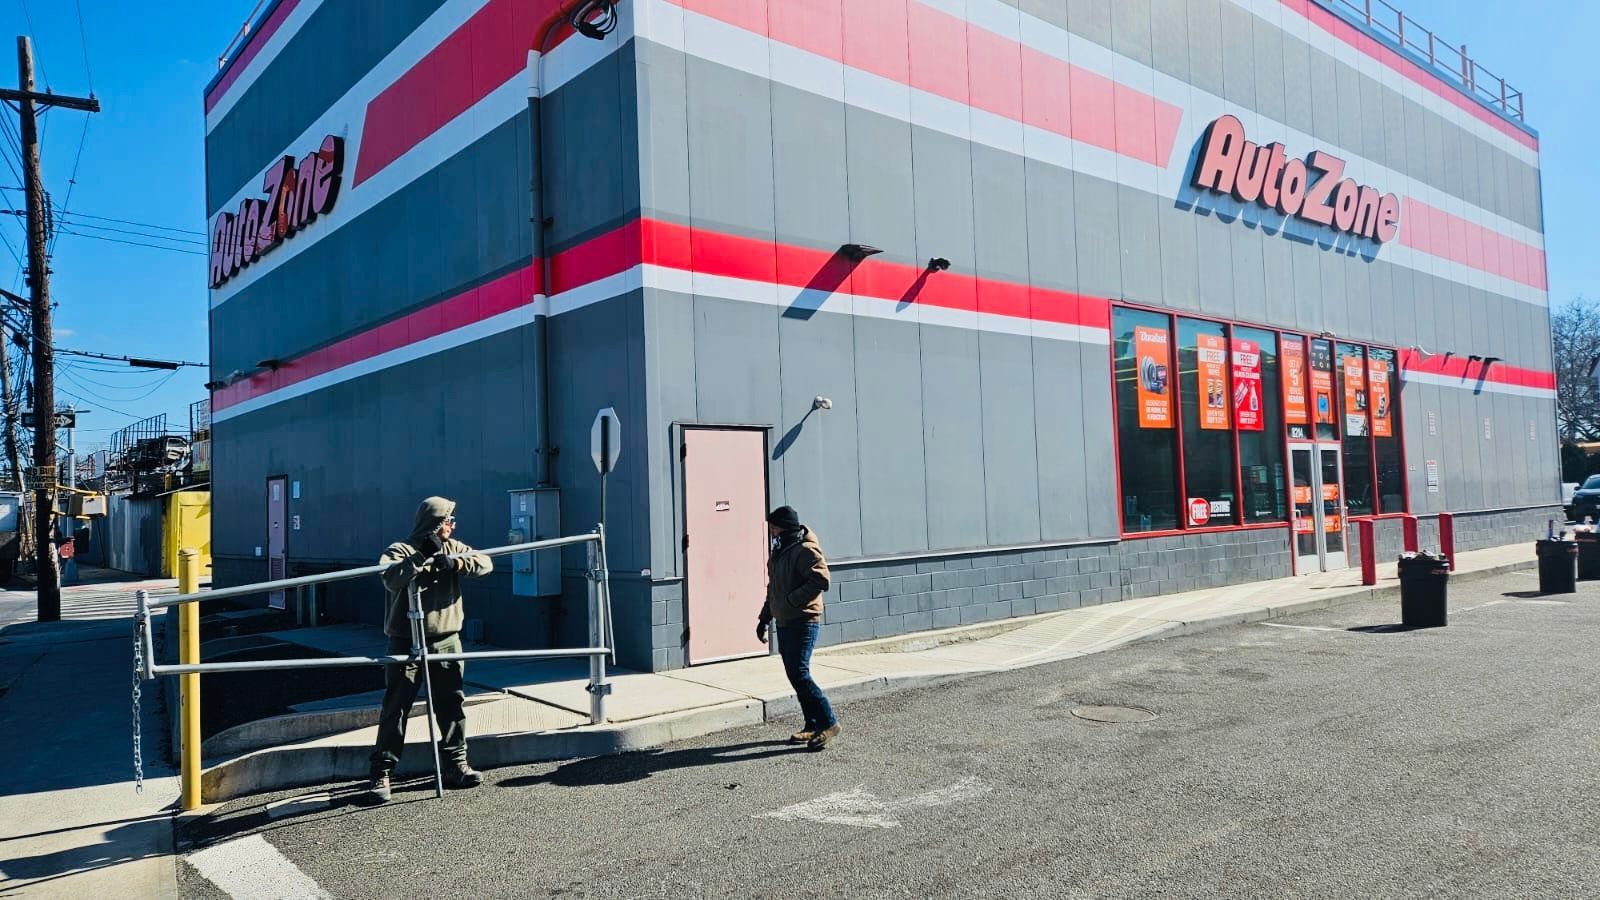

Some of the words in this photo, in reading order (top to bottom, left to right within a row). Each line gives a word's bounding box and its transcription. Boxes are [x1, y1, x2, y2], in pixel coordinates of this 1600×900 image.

[208, 134, 344, 289] AutoZone
[1190, 114, 1399, 244] AutoZone
[1240, 353, 1254, 365] FREE
[1192, 503, 1208, 519] FREE
